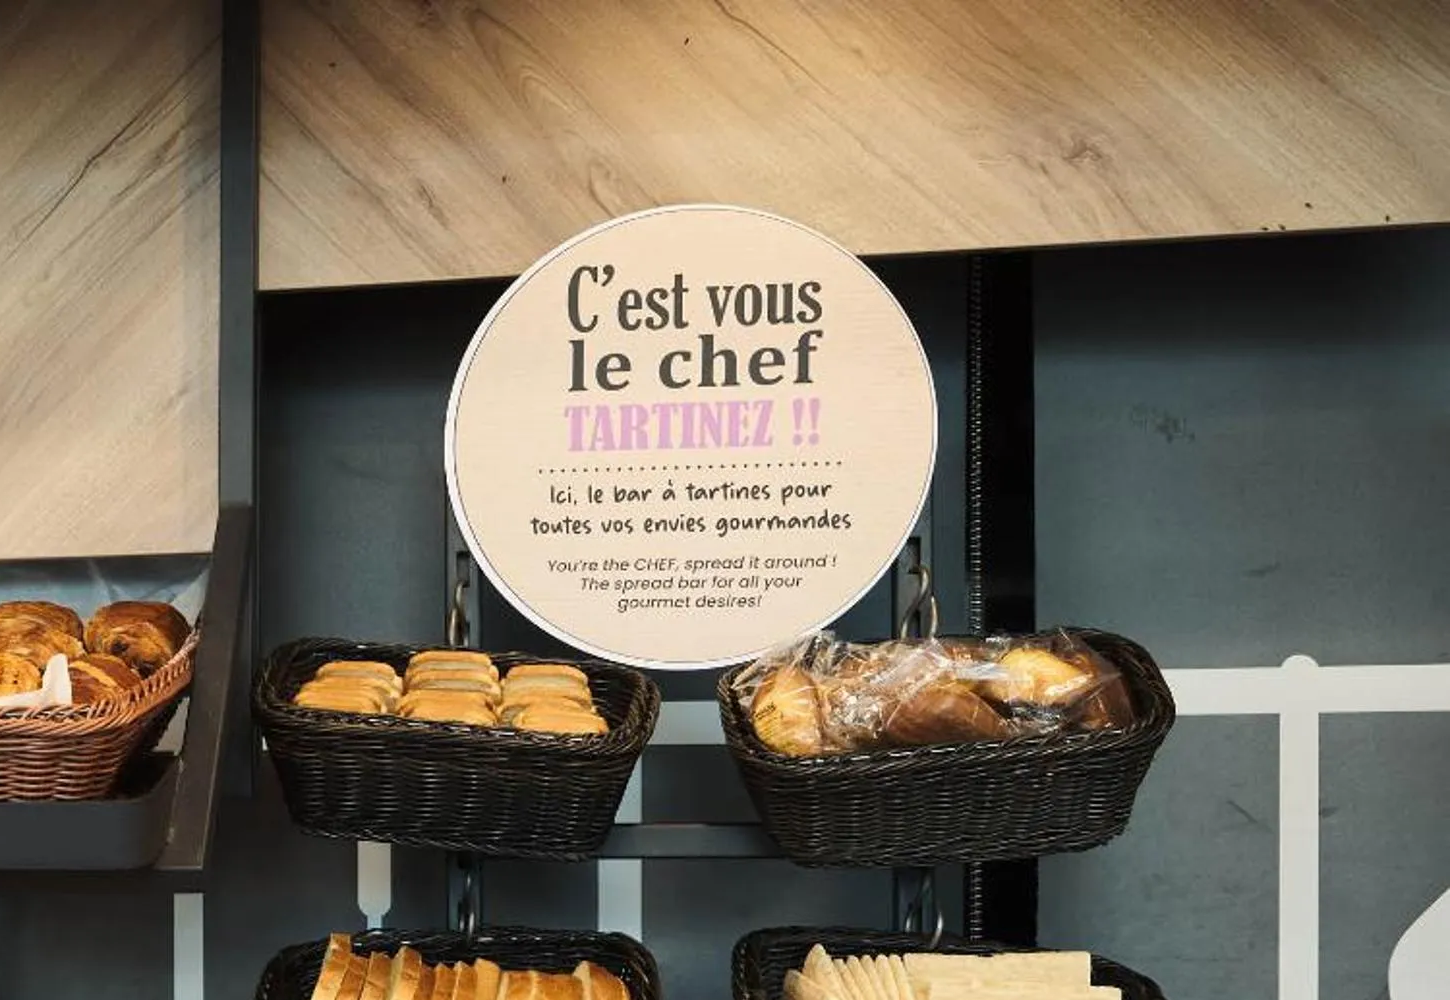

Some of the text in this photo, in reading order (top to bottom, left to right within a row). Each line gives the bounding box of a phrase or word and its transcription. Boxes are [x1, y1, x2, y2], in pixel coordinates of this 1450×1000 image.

[567, 264, 823, 333] C'est vous
[568, 330, 825, 393] le chef
[564, 398, 820, 451] TARTINEZ !!
[550, 479, 832, 506] Ici, le bar à tartines pour
[530, 508, 852, 538] toutes vos envies gourmandes
[602, 558, 630, 572] the
[633, 558, 679, 574] CHEF,
[684, 555, 746, 574] spread
[749, 556, 760, 570] it
[764, 554, 828, 570] around
[581, 575, 803, 595] The spread bar for all your
[617, 594, 763, 614] gourmet desires!
